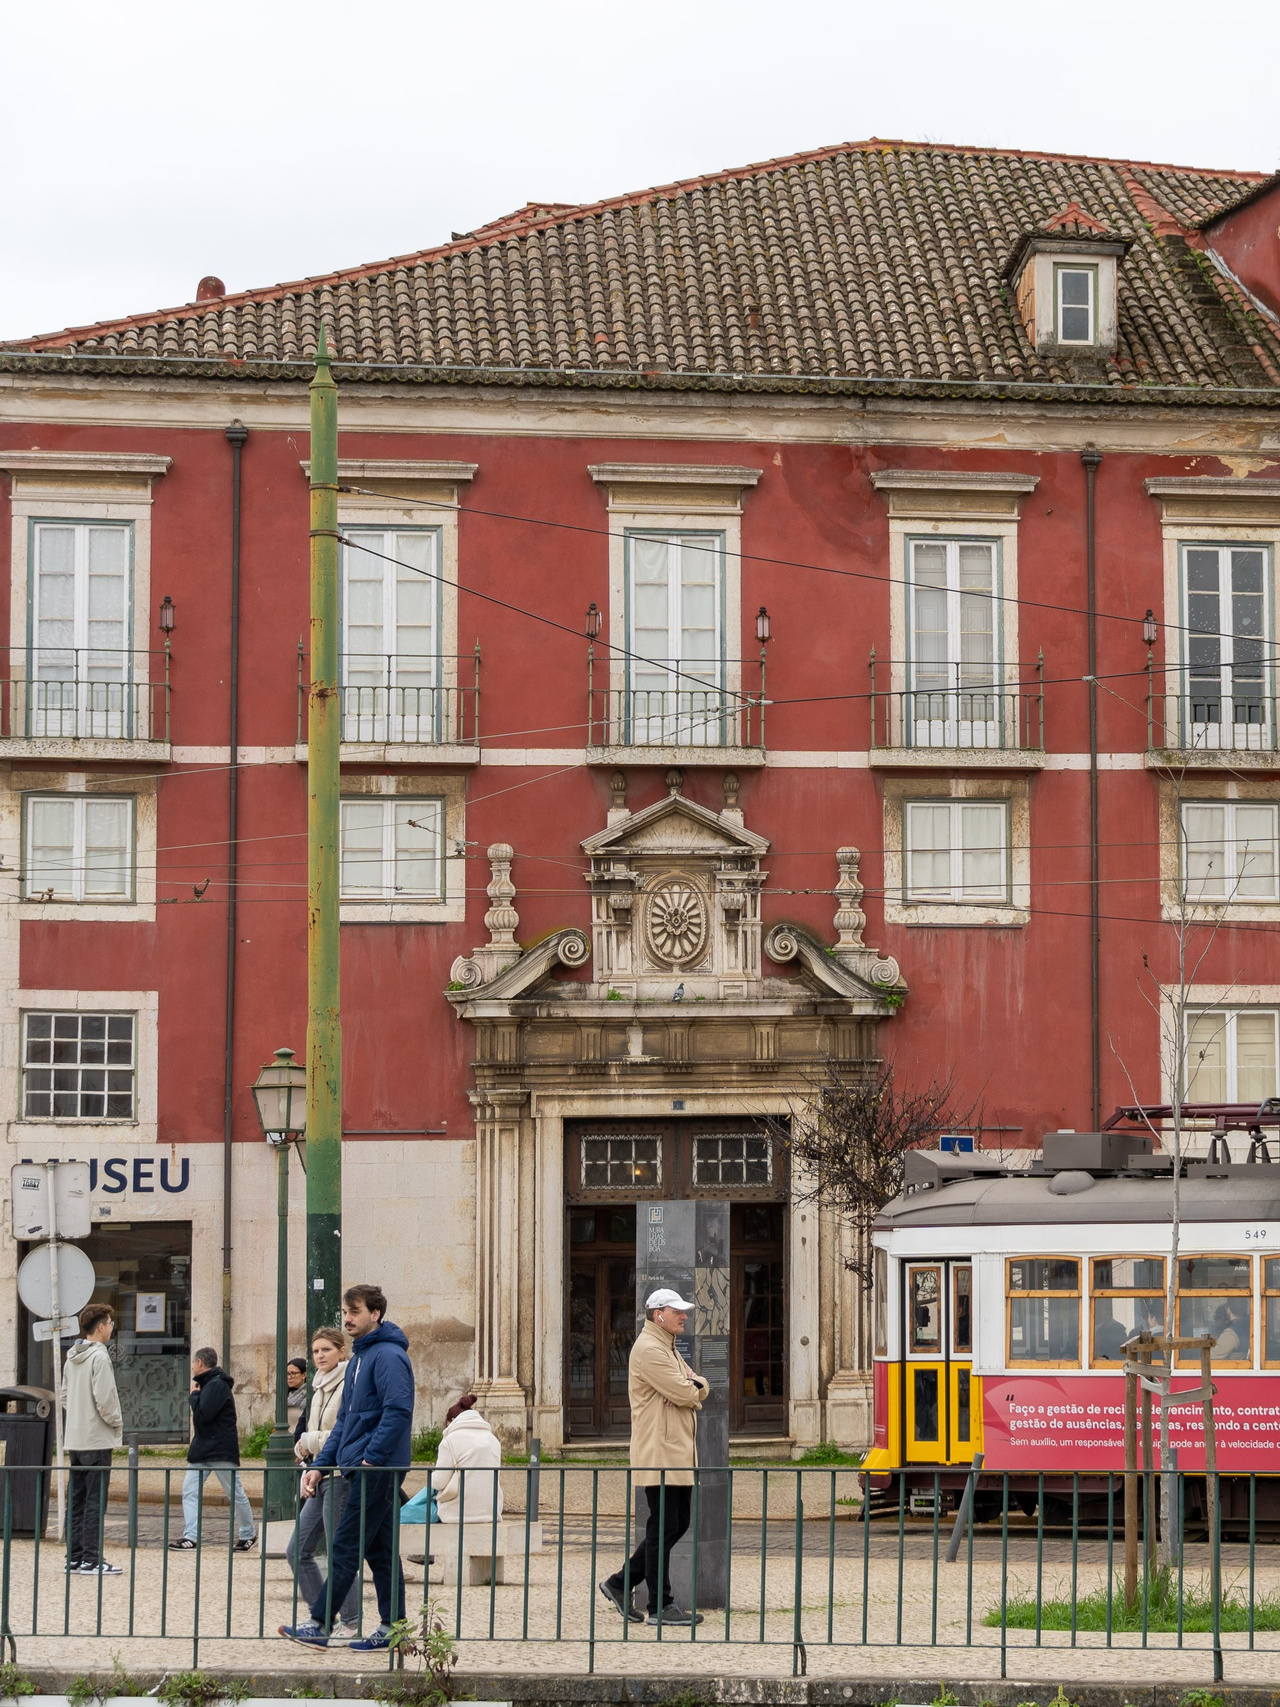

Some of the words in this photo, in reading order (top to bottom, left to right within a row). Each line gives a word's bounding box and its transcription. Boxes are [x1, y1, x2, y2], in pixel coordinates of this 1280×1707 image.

[21, 1158, 190, 1194] SEU
[1245, 1229, 1267, 1239] 549
[1009, 1403, 1035, 1416] Faço
[1038, 1405, 1044, 1414] a
[1047, 1403, 1084, 1416] gestão
[1087, 1404, 1101, 1414] de
[1010, 1418, 1047, 1431] gestão
[1050, 1419, 1064, 1429] de
[1066, 1419, 1125, 1430] ausências,
[1243, 1423, 1250, 1431] a
[1010, 1437, 1028, 1446] Sem
[1030, 1436, 1058, 1447] auxílio,
[1074, 1437, 1125, 1448] responsável
[1170, 1439, 1192, 1449] pode
[1220, 1439, 1226, 1448] à
[1228, 1439, 1274, 1449] velocidade
